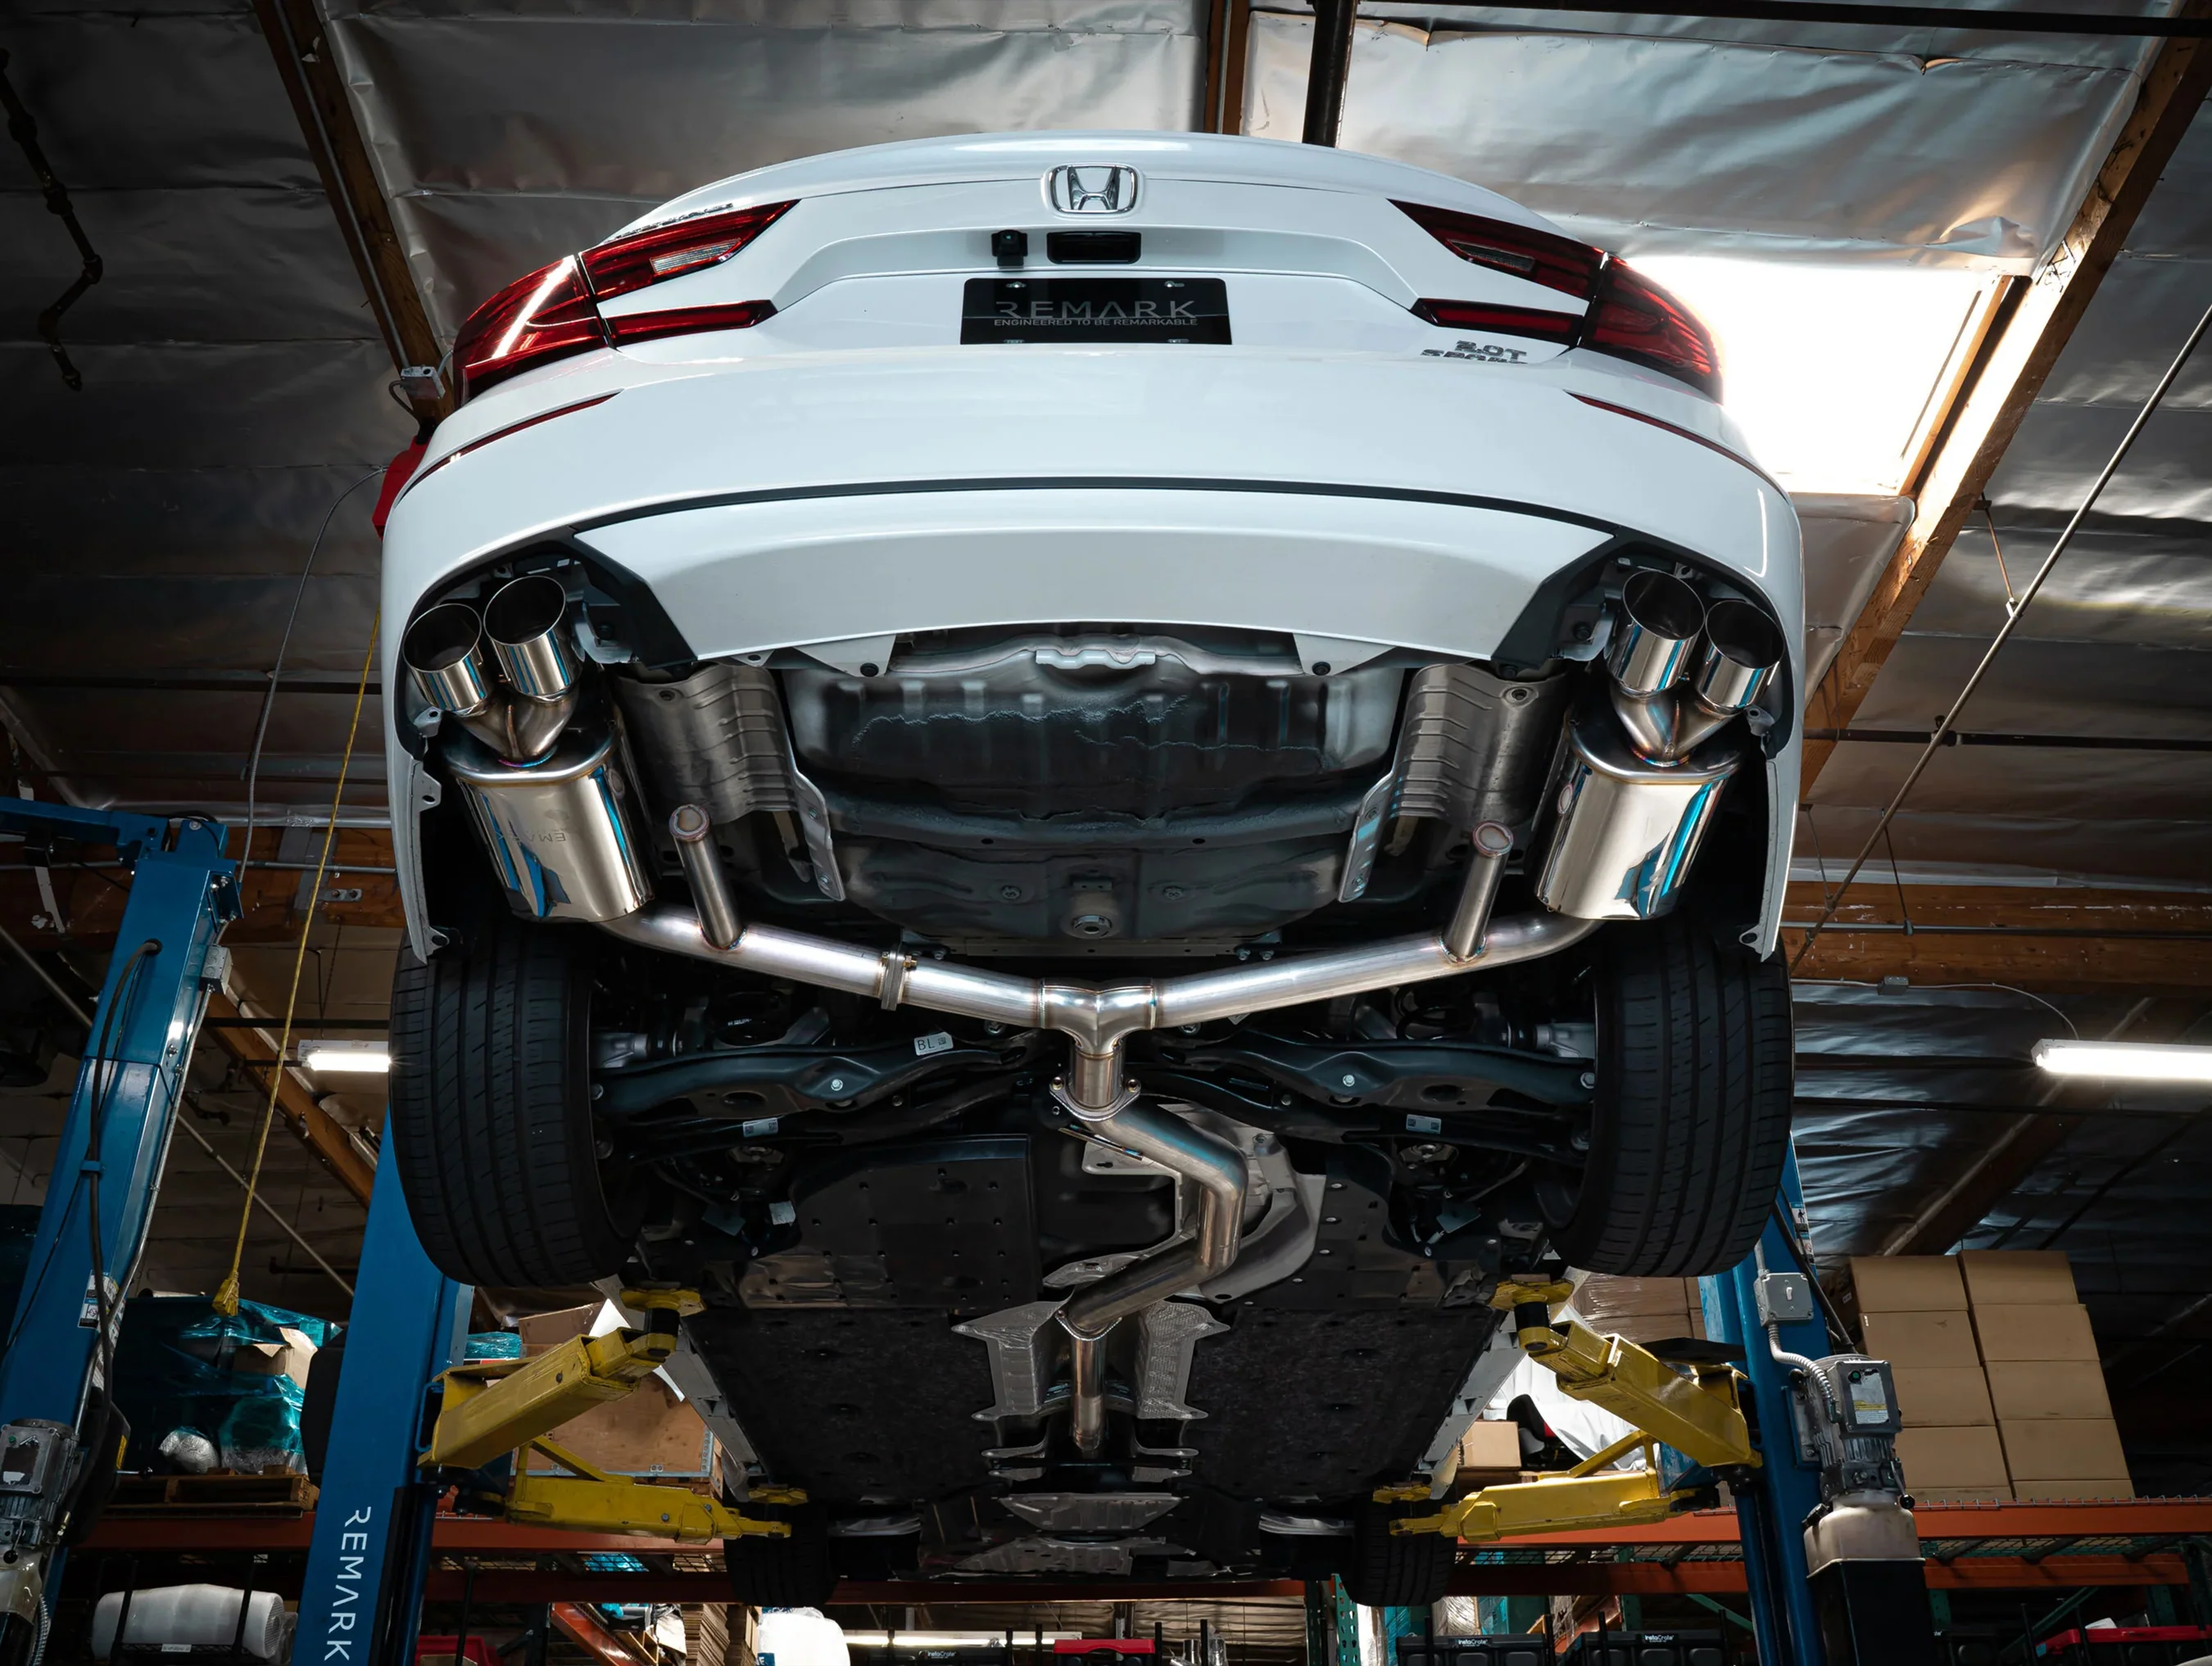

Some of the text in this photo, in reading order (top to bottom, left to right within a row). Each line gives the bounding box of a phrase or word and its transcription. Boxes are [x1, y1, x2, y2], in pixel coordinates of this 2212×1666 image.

[995, 301, 1196, 319] REMARK
[1113, 318, 1198, 326] REMARKABLE
[1420, 349, 1529, 364] SPOR
[1454, 340, 1527, 362] 2.0T
[918, 1038, 936, 1051] BL
[324, 1506, 372, 1662] REMARK
